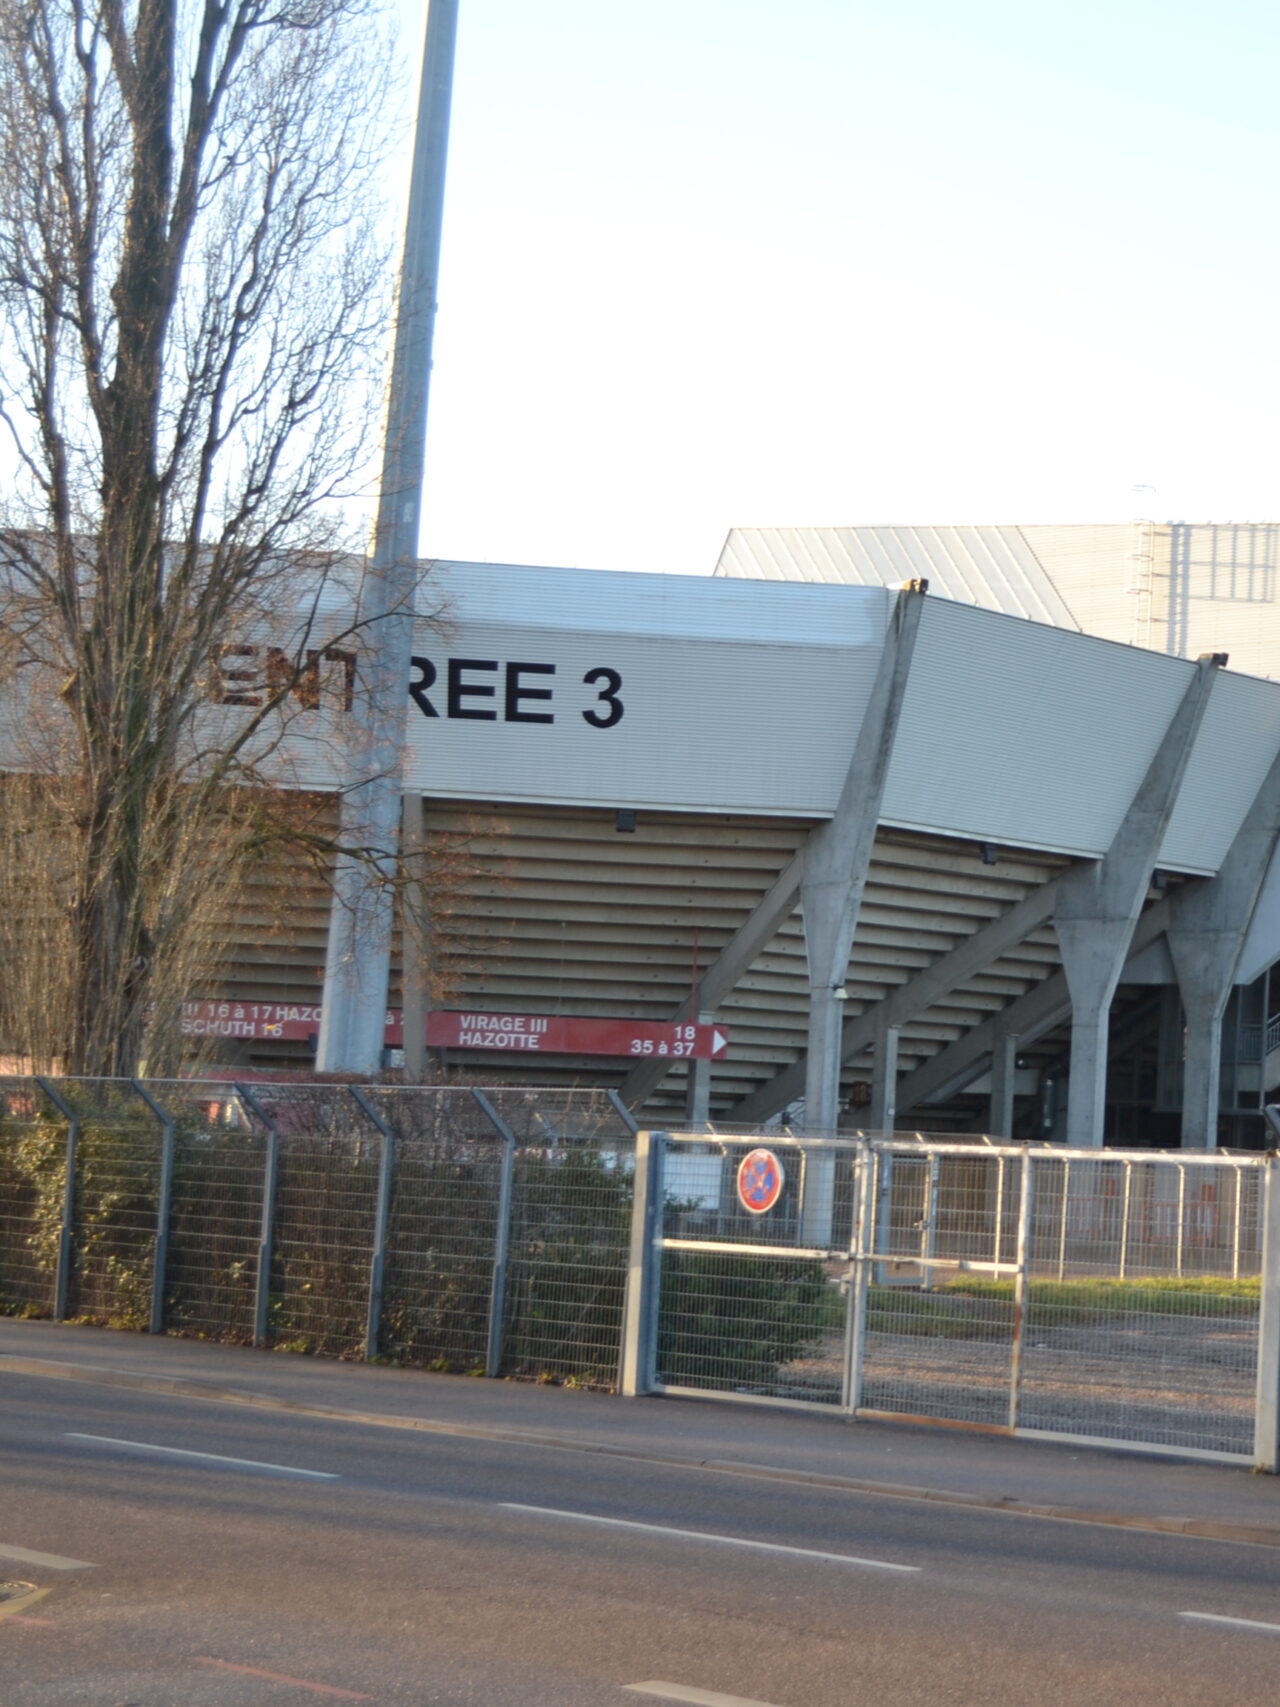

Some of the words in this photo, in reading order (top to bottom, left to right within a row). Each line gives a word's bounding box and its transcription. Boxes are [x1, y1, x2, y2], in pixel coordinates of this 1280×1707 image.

[214, 644, 557, 725] ENTREE
[581, 667, 625, 729] 3
[208, 1004, 230, 1018] 16
[235, 1005, 244, 1019] à
[251, 1005, 273, 1020] 17
[460, 1015, 525, 1032] VIRAGE
[530, 1018, 548, 1033] III
[674, 1025, 696, 1040] 18
[459, 1031, 539, 1049] HAZOTTE
[631, 1039, 654, 1054] 35
[658, 1040, 668, 1055] à
[673, 1041, 695, 1056] 37
